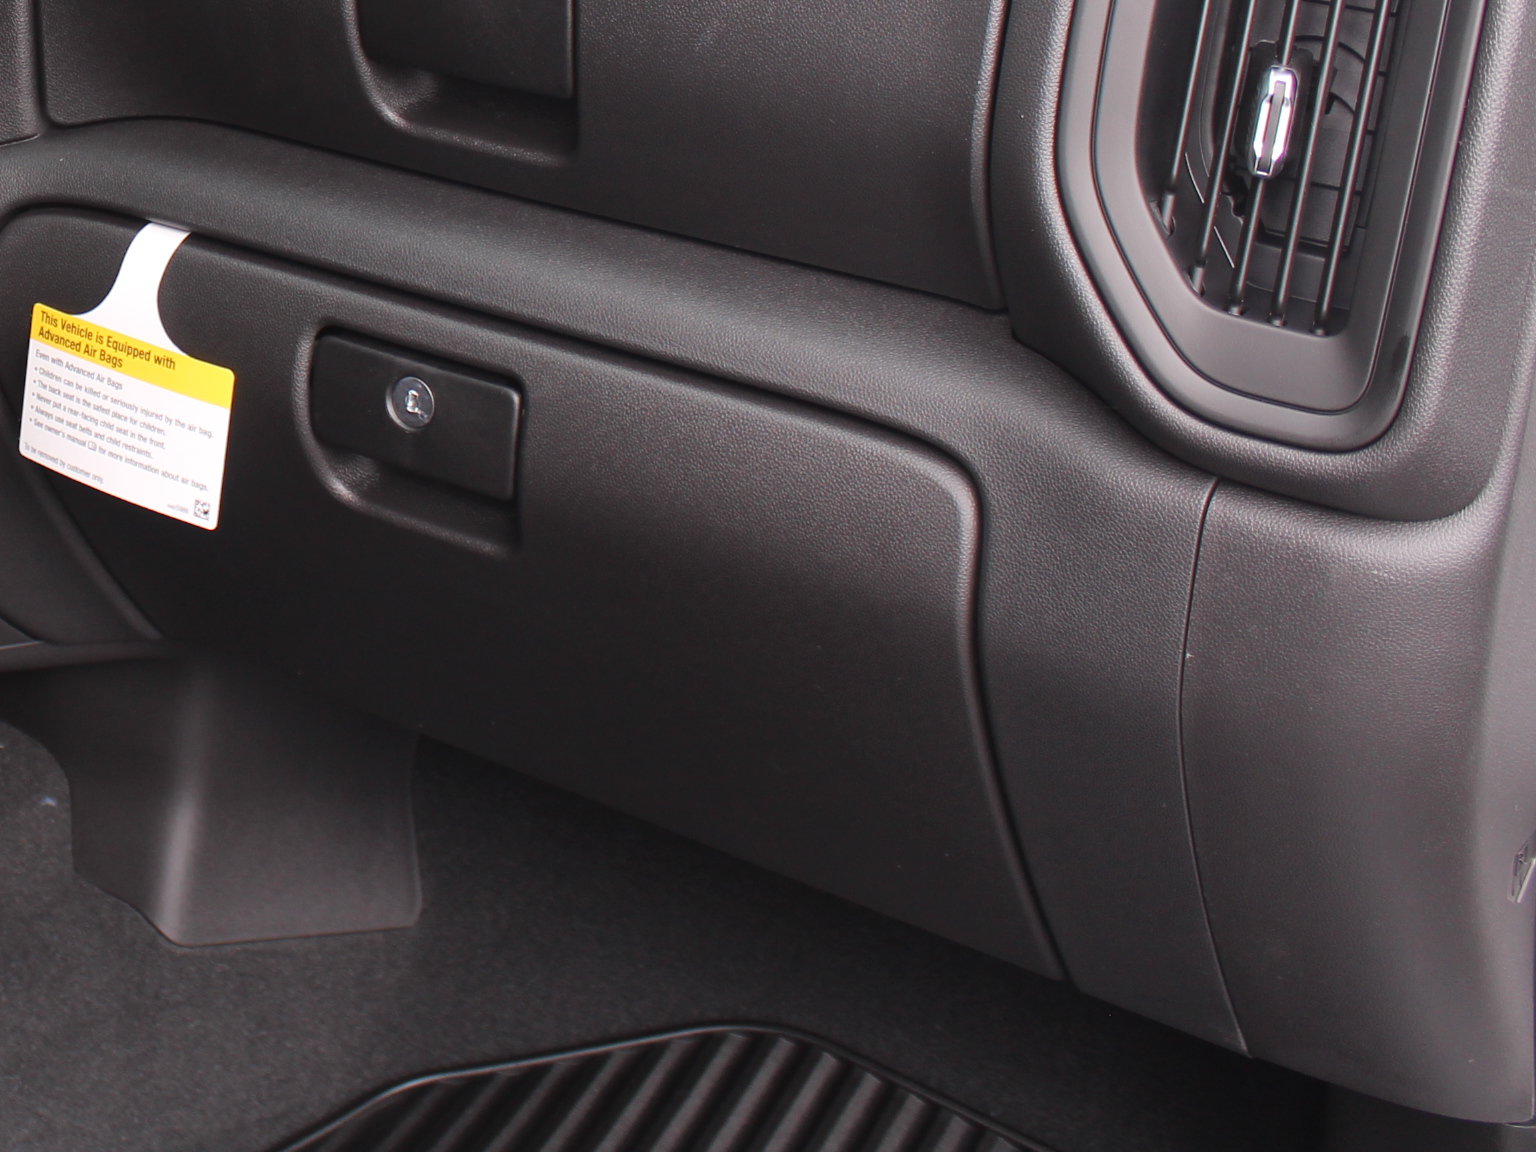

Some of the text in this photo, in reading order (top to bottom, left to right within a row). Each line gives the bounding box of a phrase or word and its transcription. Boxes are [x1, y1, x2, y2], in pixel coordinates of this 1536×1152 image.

[39, 326, 123, 368] Advanced Air Bags
[41, 311, 176, 370] This Vehicle is Equipped with
[36, 349, 122, 390] Even with Advanced Air Bags
[35, 406, 53, 420] Always
[79, 424, 92, 436] belts
[94, 432, 105, 441] and
[106, 436, 121, 447] child
[36, 392, 51, 405] Never
[68, 407, 98, 426] rear-facing
[100, 420, 114, 430] child
[116, 426, 128, 436] seat
[130, 430, 135, 438] in
[138, 434, 147, 443] the
[38, 380, 47, 390] The
[48, 384, 61, 396] back
[82, 398, 91, 407] the
[93, 404, 110, 415] safest
[112, 411, 128, 423] place
[130, 416, 138, 426] for
[39, 368, 213, 438] Children can be killed or seriously injured by the air bag.
[66, 434, 86, 447] manual
[108, 450, 123, 461] more
[125, 457, 159, 475] information
[161, 470, 180, 482] about
[181, 477, 189, 485] air
